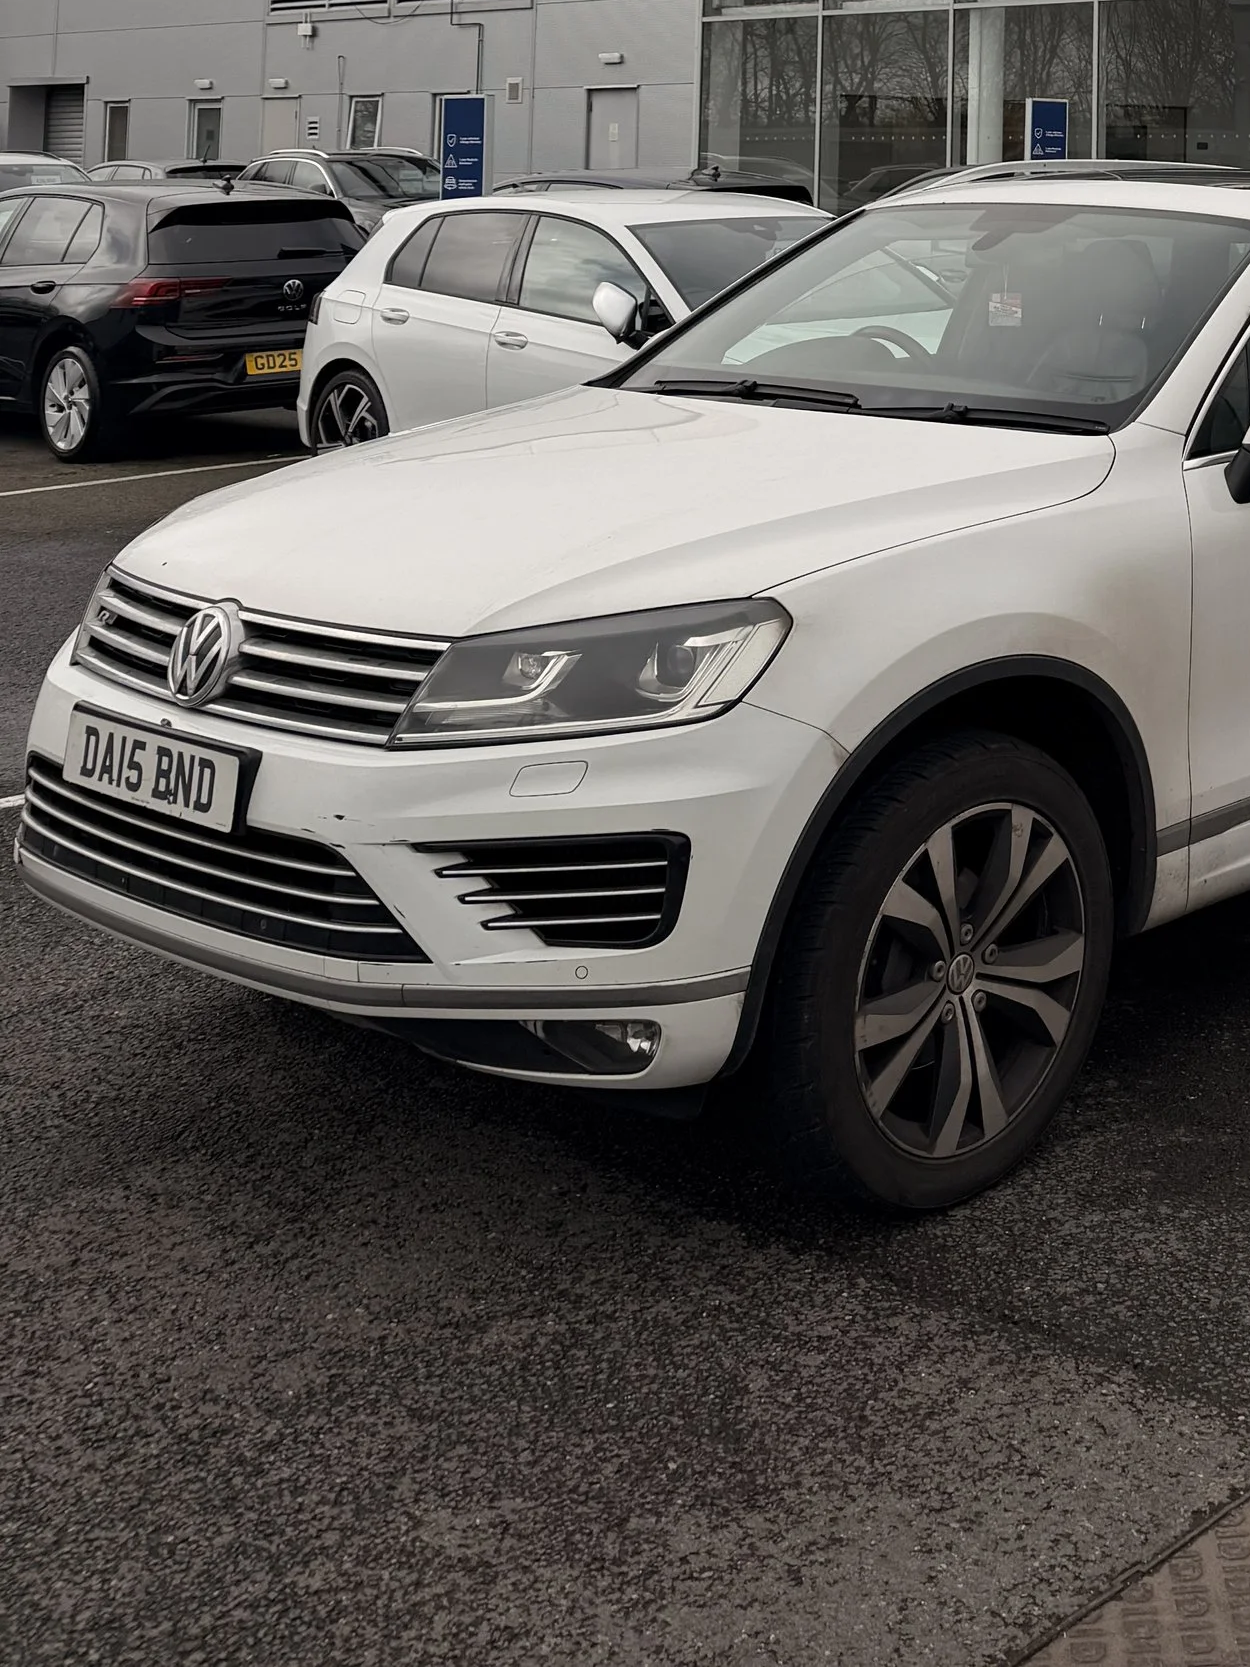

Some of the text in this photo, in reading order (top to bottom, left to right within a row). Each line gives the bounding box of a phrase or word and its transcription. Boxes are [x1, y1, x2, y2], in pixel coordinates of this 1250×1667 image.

[254, 352, 298, 370] GD25
[168, 606, 231, 706] VW
[80, 725, 216, 813] DA15 BND
